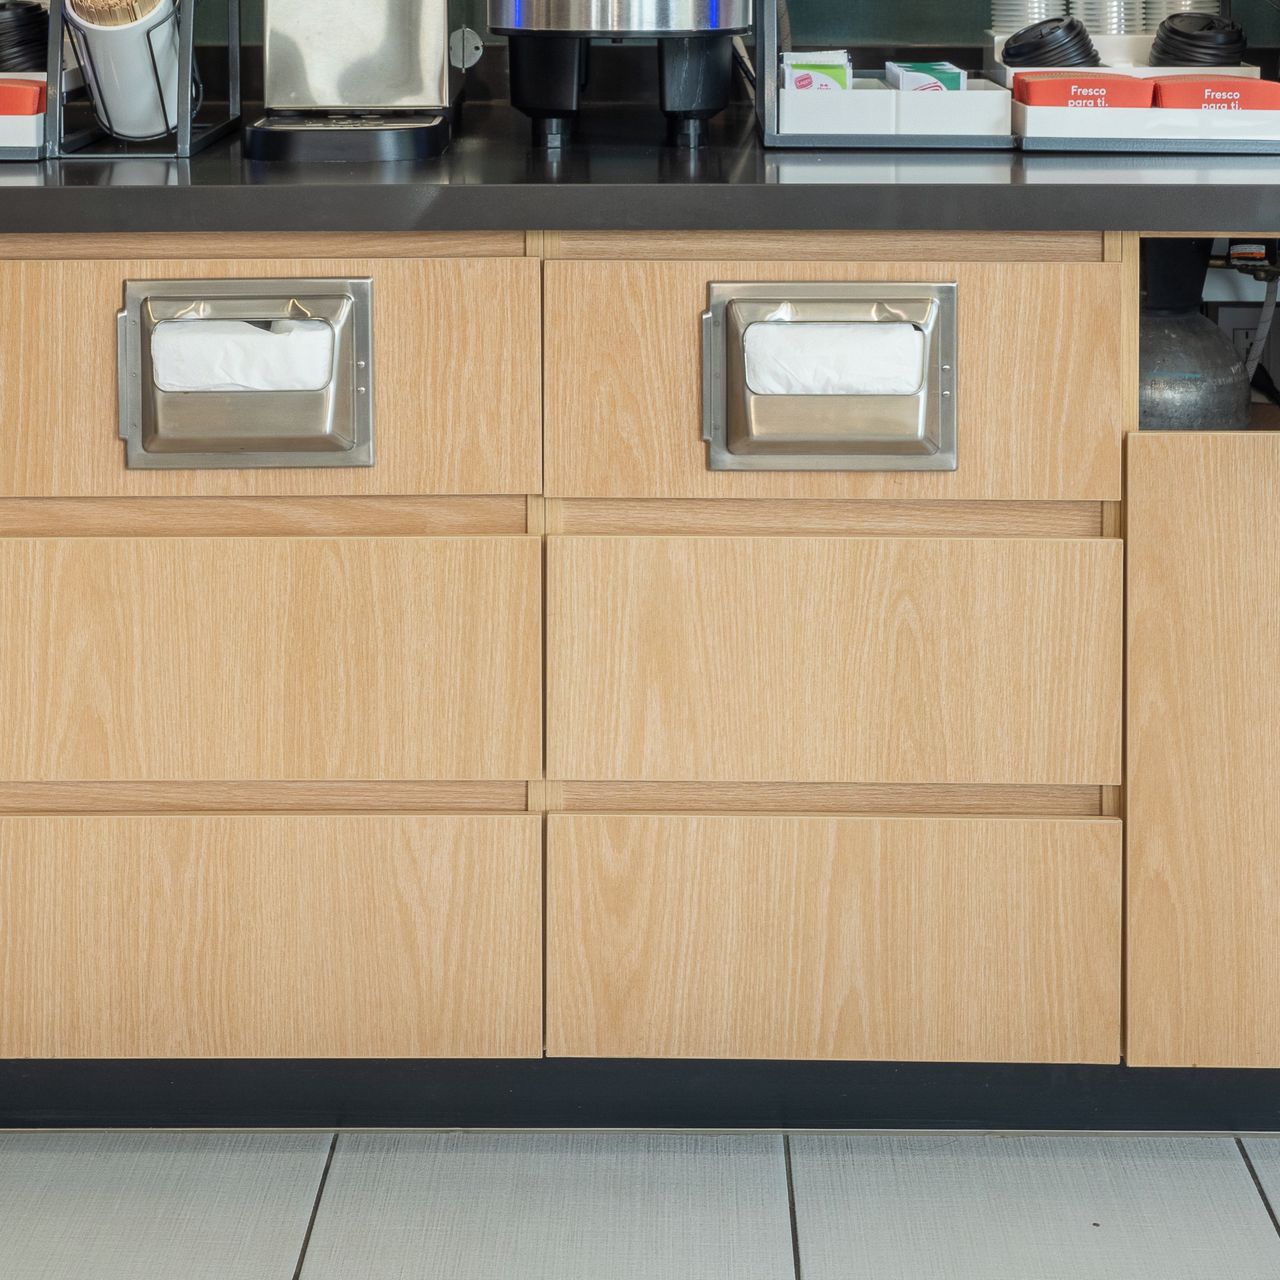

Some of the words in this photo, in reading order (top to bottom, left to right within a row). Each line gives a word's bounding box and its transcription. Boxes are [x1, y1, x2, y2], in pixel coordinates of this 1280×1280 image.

[1071, 85, 1107, 96] Fresco
[1204, 88, 1240, 100] Fresco
[1068, 98, 1094, 107] para
[1097, 97, 1109, 107] ti.
